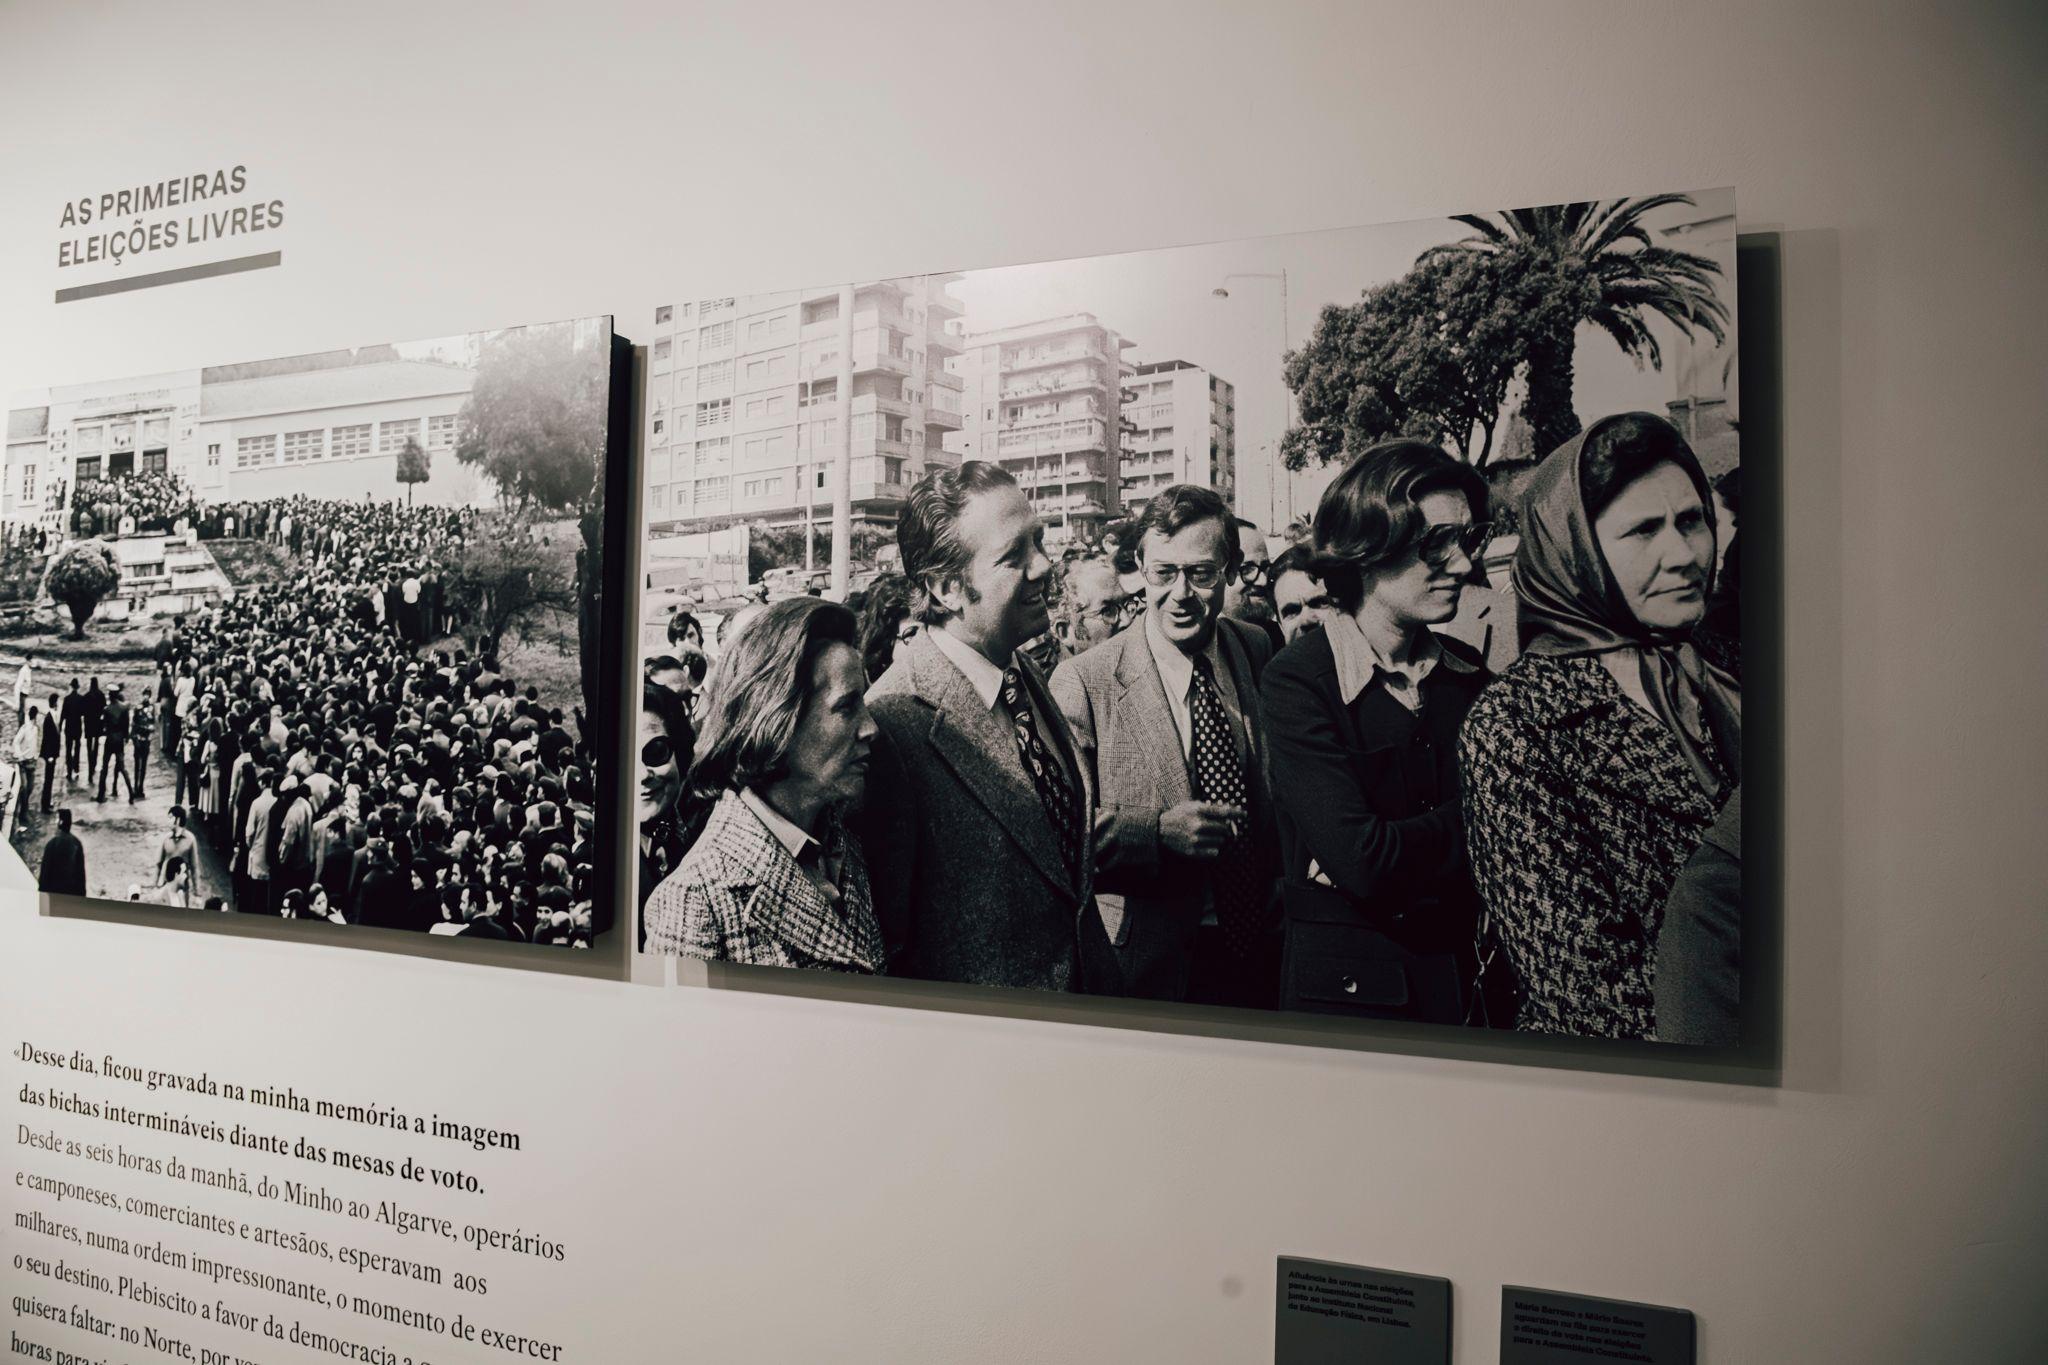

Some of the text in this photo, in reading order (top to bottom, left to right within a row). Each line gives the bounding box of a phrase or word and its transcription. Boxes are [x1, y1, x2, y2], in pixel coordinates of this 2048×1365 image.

[58, 200, 284, 267] ELEIÇÕES LIVRES
[60, 165, 247, 228] AS PRIMEIRAS
[20, 1083, 484, 1194] das bichas intermináveis diante das mesas de voto.
[70, 1050, 98, 1077] dia,
[104, 1055, 142, 1082] ficou
[147, 1071, 217, 1096] gravada
[223, 1084, 244, 1101] na
[251, 1086, 310, 1113] minha
[316, 1101, 408, 1131] memória
[414, 1118, 425, 1134] a
[432, 1114, 520, 1151] imagem
[16, 1172, 487, 1295] e camponeses, comerciantes e artesãos, esperavam aos
[18, 1124, 564, 1261] Desde as seis horas da manhã, do Minho ao Algarve, operários
[13, 1296, 230, 1365] quisera faltar: no Norte, por
[14, 1255, 396, 1365] o seu destino. Plebiscito a favor da democracia
[15, 1211, 562, 1362] milhares, numa ordem impressionante, o momento de exercer
[11, 1330, 52, 1363] horas
